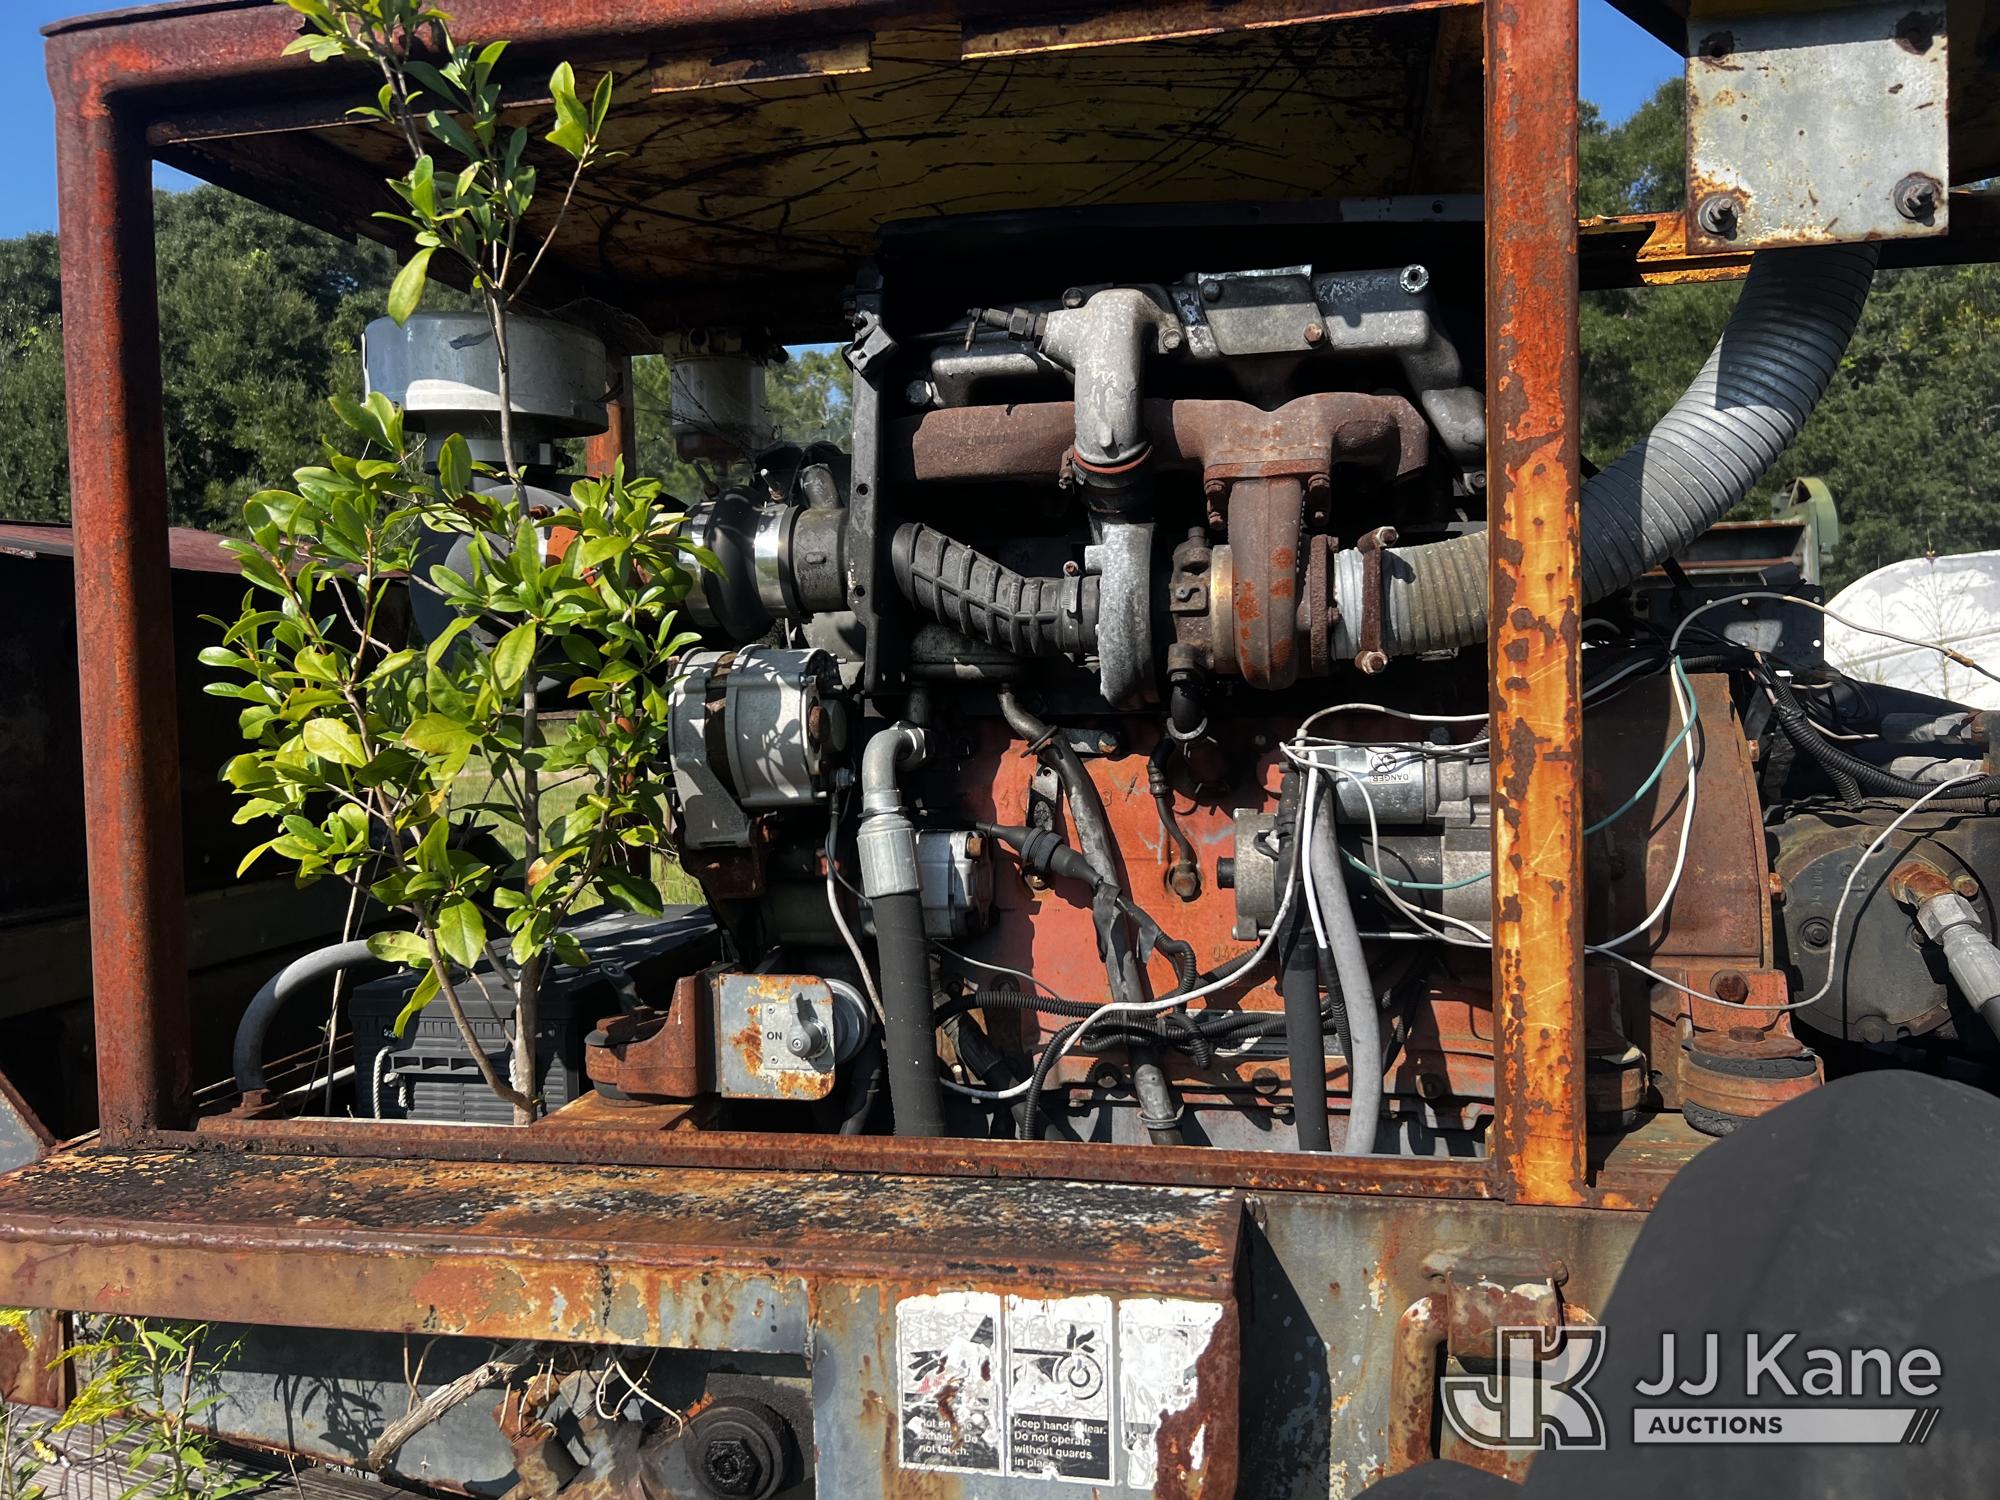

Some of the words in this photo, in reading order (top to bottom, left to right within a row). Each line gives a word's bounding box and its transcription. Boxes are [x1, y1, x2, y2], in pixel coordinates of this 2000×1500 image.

[1372, 773, 1409, 782] DANGER
[767, 1032, 783, 1040] ON
[1014, 1417, 1041, 1431] Keep
[1079, 1423, 1108, 1435] lear.
[963, 1433, 979, 1444] Do
[1014, 1430, 1029, 1441] Do
[1031, 1433, 1049, 1443] not
[1051, 1435, 1092, 1446] operate
[919, 1444, 936, 1454] not
[1014, 1445, 1053, 1457] without
[1055, 1449, 1093, 1460] guards
[1014, 1457, 1025, 1466] in
